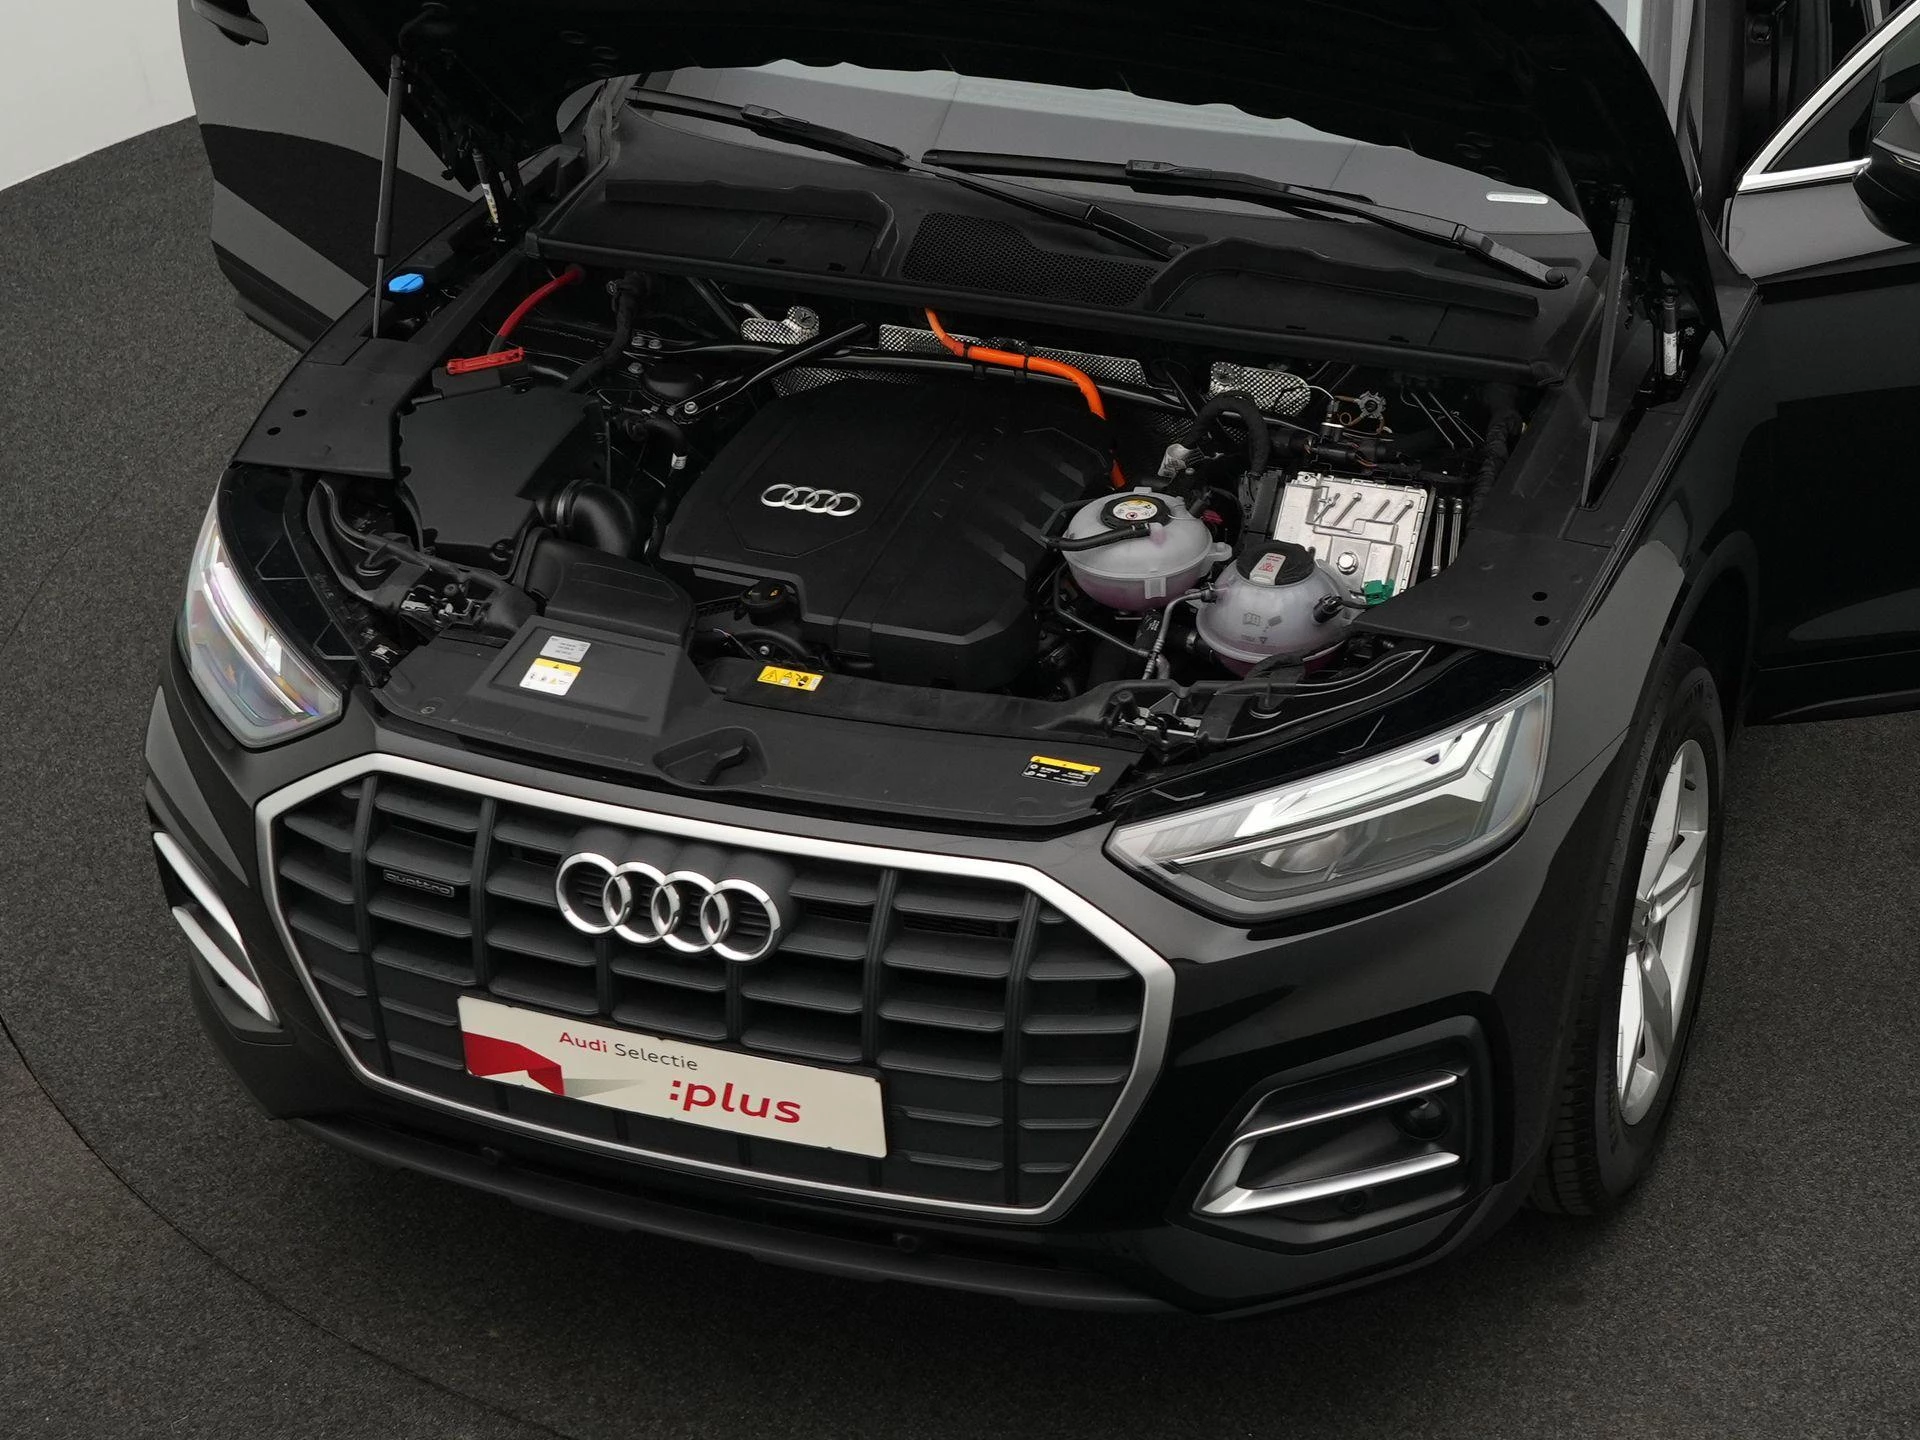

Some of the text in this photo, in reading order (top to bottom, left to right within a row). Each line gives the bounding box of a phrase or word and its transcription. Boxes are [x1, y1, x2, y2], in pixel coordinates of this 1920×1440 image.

[385, 873, 450, 894] quattro
[559, 1031, 698, 1070] Audi Selectie
[668, 1080, 801, 1124] :plus
